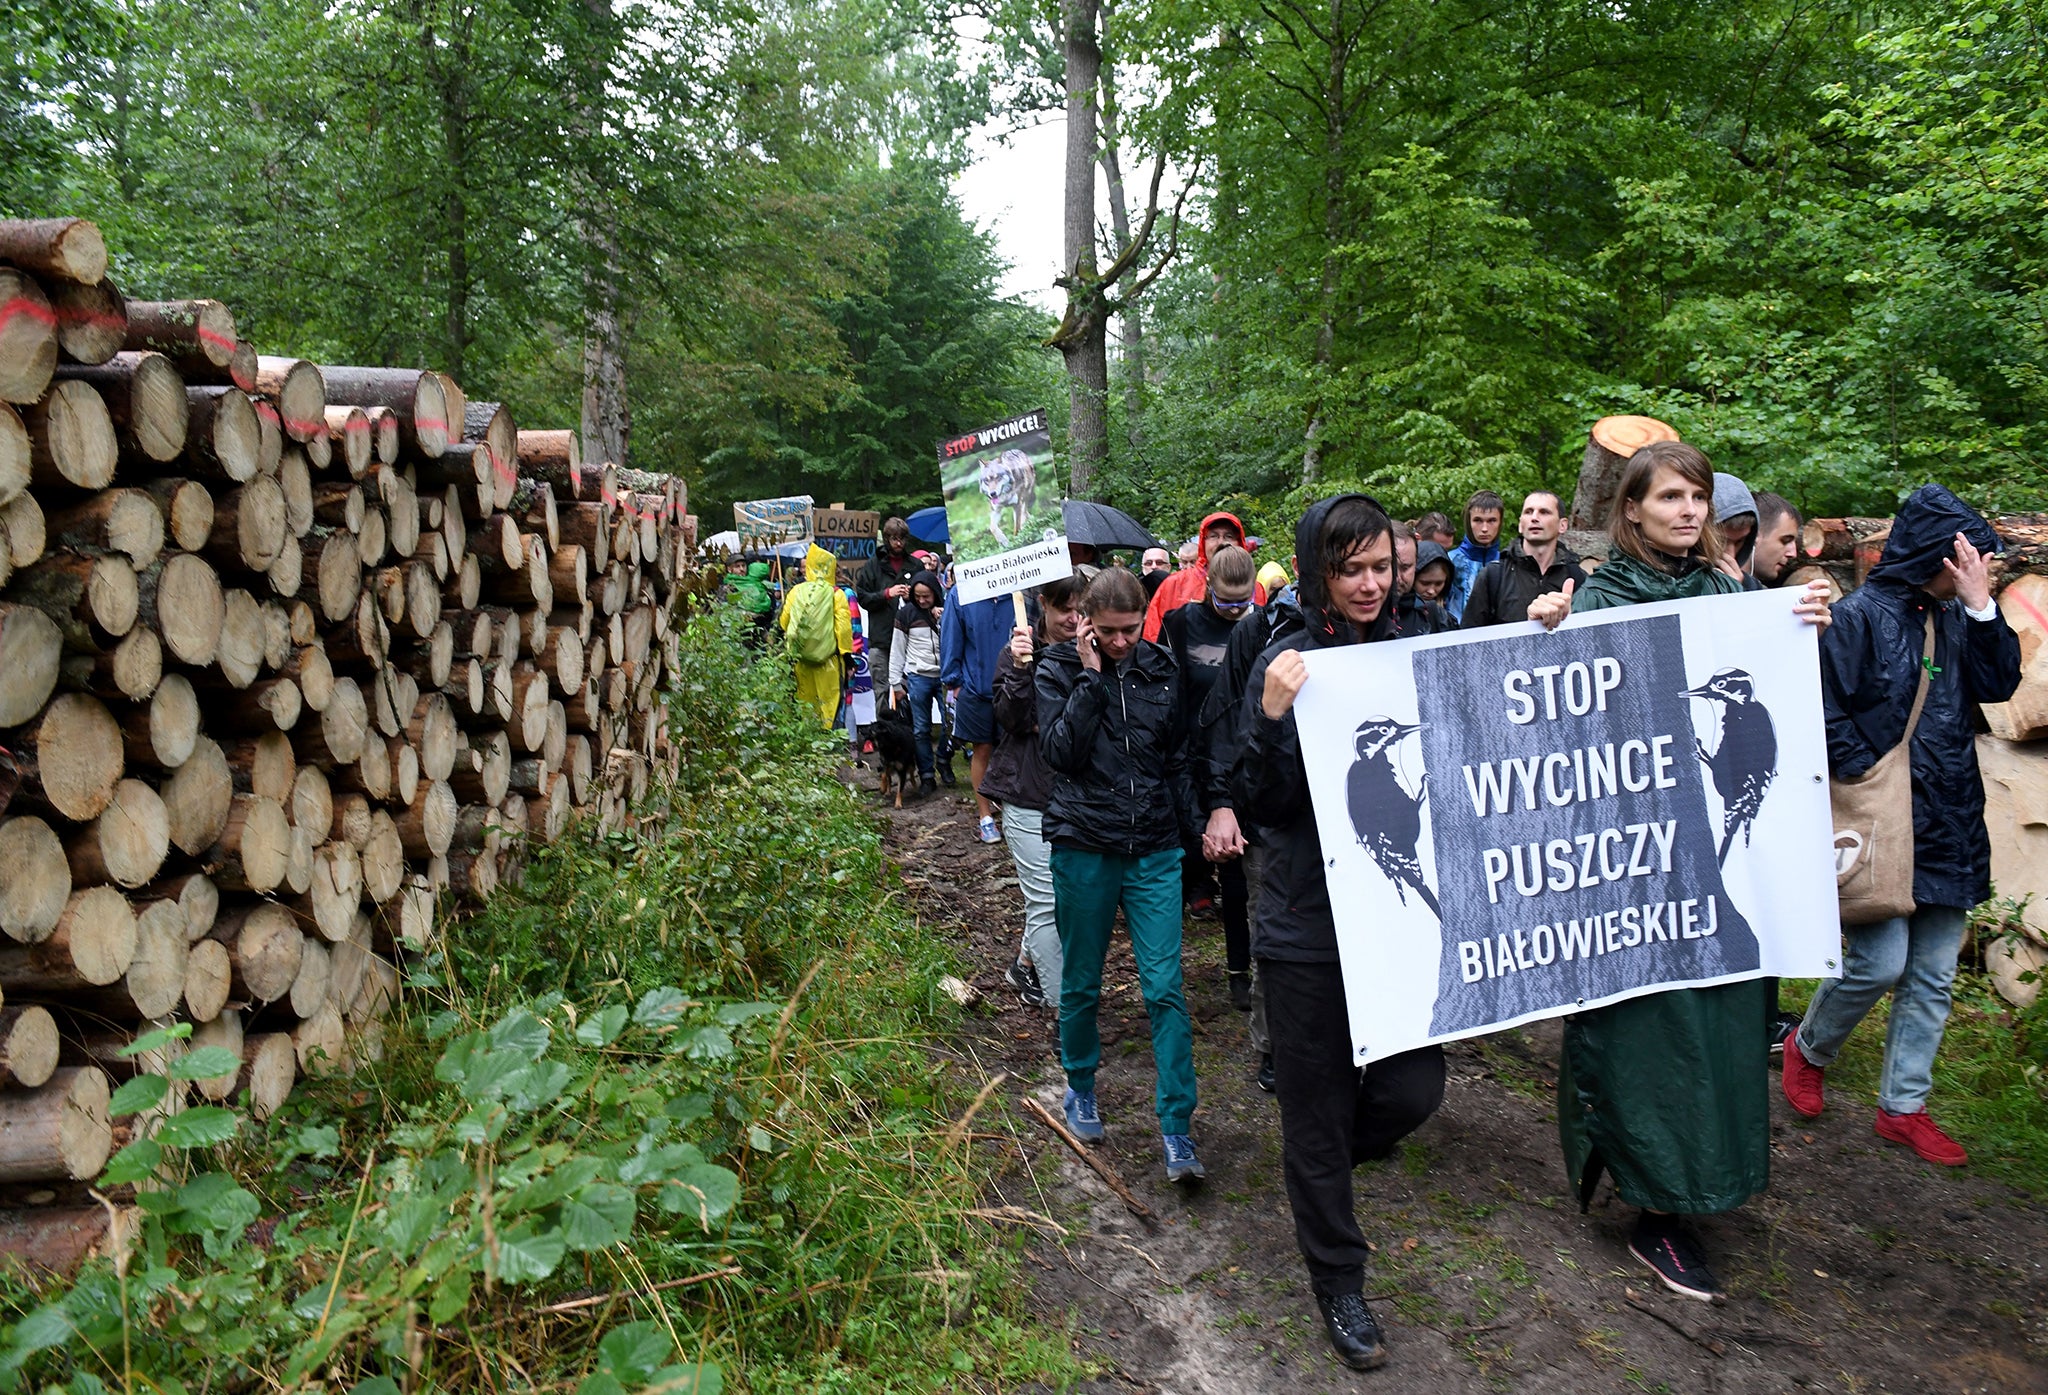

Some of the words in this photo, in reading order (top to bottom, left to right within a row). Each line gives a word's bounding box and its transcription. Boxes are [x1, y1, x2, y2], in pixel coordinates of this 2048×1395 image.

[945, 435, 977, 457] STOP
[978, 414, 1040, 446] WYCINCE!
[818, 516, 875, 533] LOKALSI
[963, 562, 1000, 580] Puszcza
[1002, 546, 1060, 570] Białowieska
[986, 579, 998, 589] to
[999, 573, 1018, 586] mój
[1020, 567, 1042, 581] dom
[1503, 656, 1622, 726] STOP
[1462, 734, 1678, 818] WYCINCE
[1483, 820, 1678, 904] PUSZCZY
[1458, 894, 1719, 984] BIAŁOWIESKIEJ
